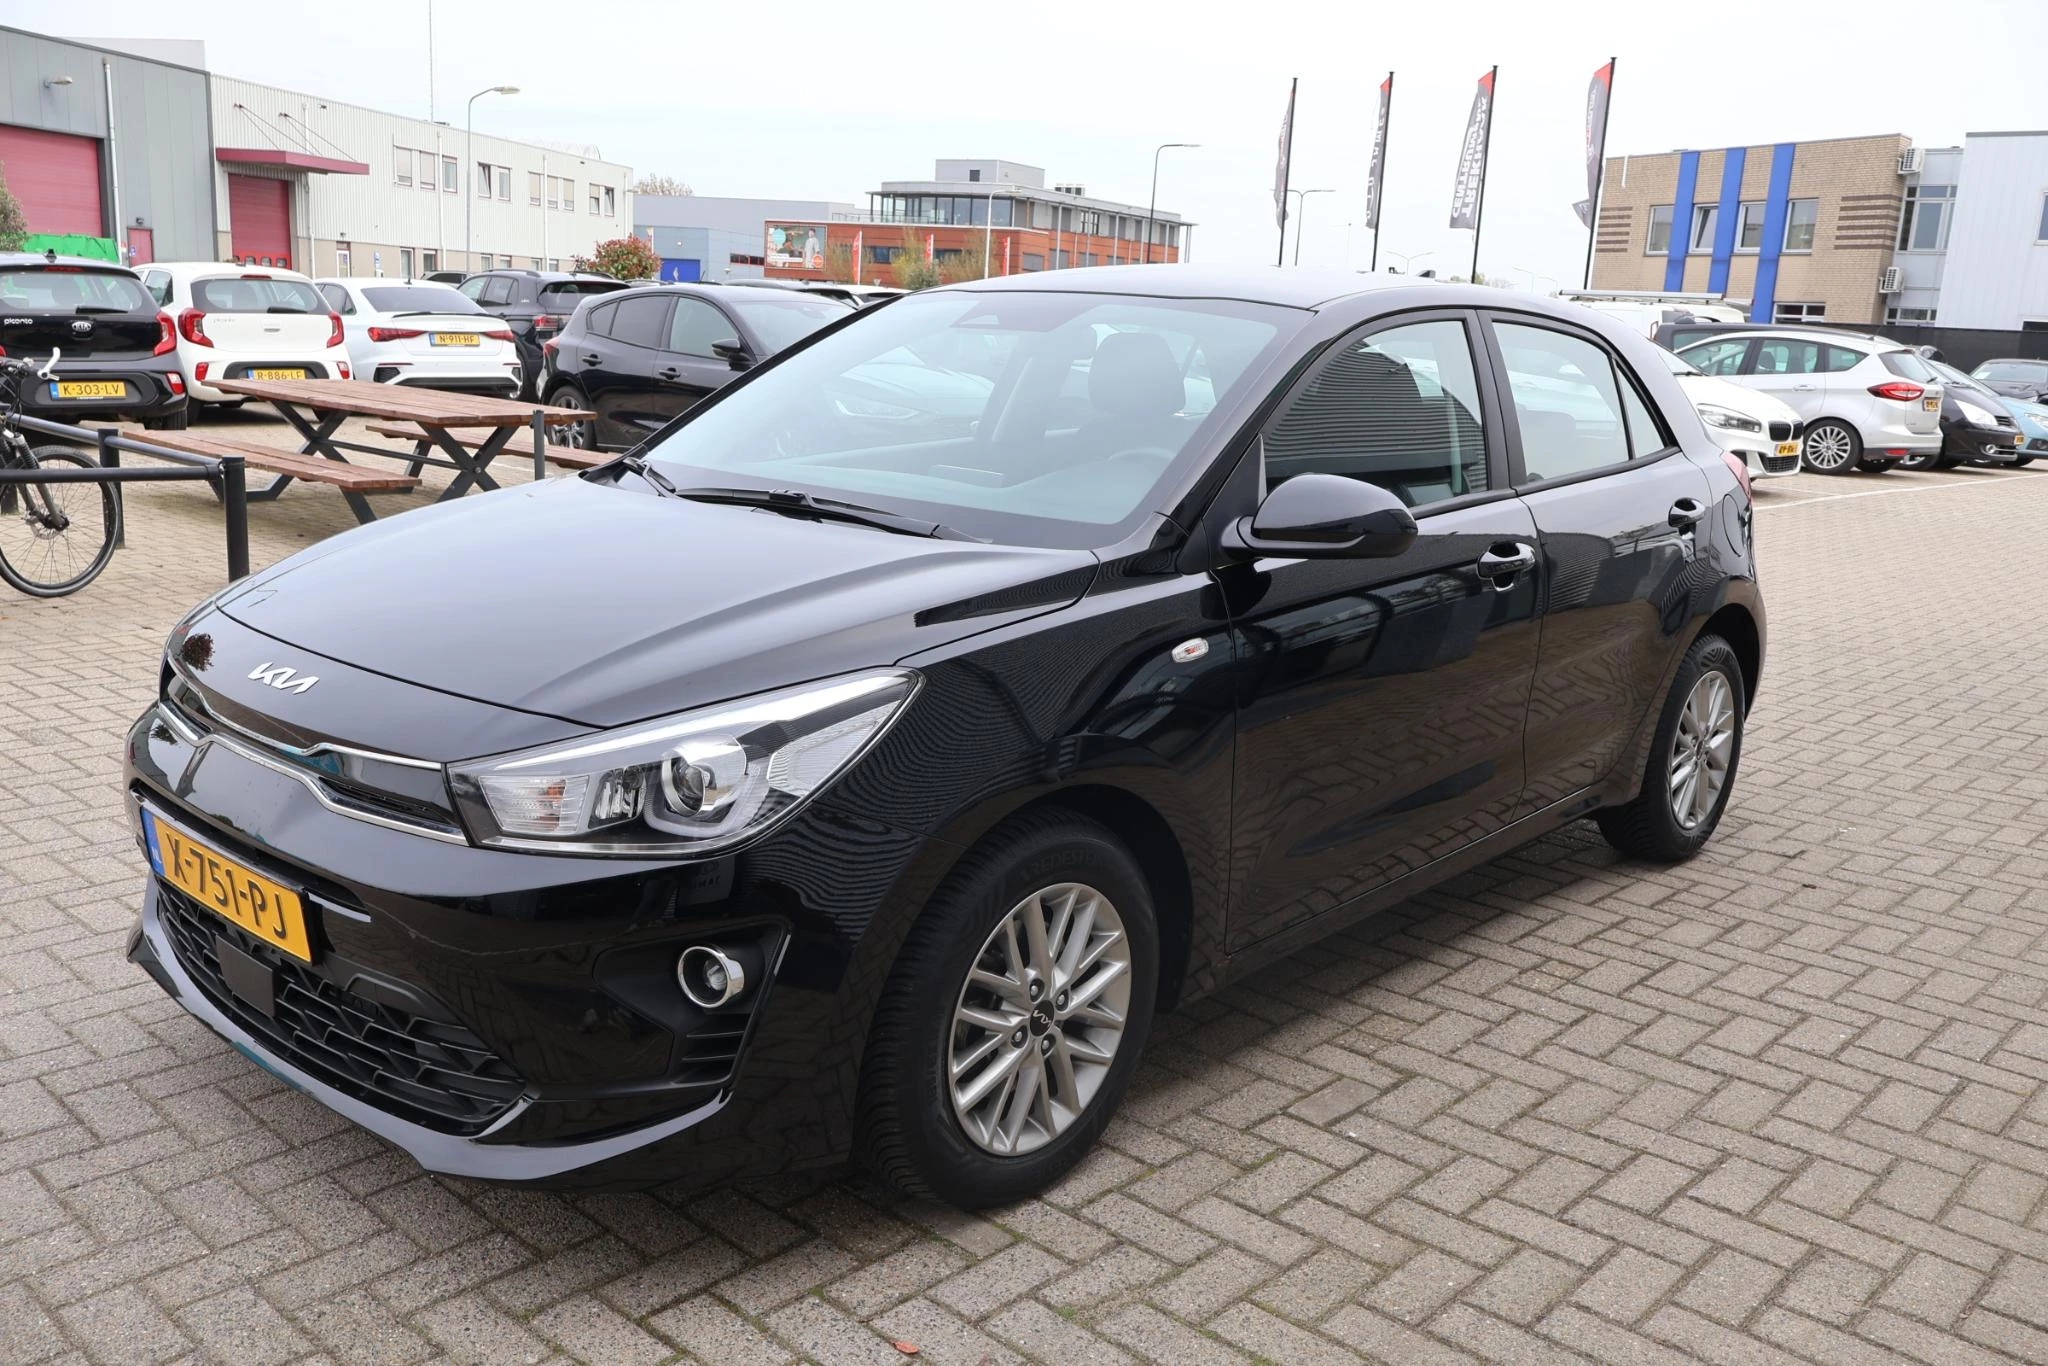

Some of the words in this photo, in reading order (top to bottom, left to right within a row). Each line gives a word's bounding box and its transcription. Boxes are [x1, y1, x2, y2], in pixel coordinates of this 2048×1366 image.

[4, 317, 33, 326] picanto
[63, 384, 119, 395] K-303-LV
[167, 832, 288, 939] X-751-PJ
